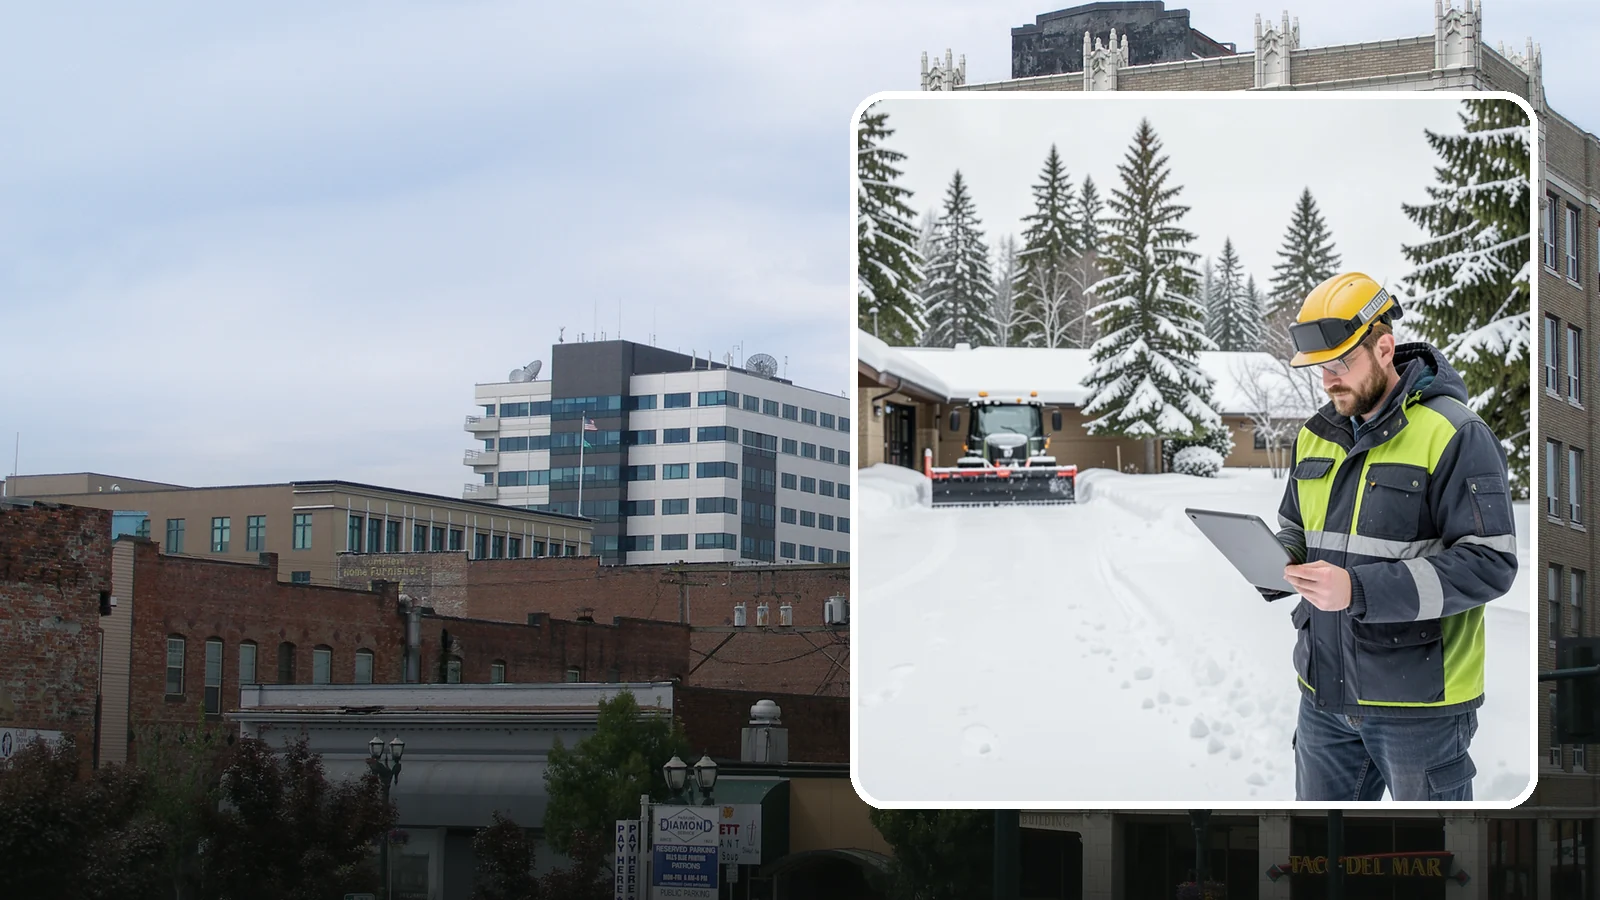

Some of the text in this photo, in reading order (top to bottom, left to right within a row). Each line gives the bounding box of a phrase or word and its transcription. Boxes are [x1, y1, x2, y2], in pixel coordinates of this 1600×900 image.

[343, 566, 427, 577] Home Furnishers
[660, 818, 713, 833] DIAMOND
[1022, 815, 1070, 828] BUILDING
[689, 846, 716, 854] PARKING
[616, 825, 625, 893] PAY HERE
[627, 824, 636, 893] PAY HERE
[721, 852, 739, 862] Soup
[671, 862, 701, 870] PATRONS
[1289, 855, 1442, 877] TAC DEL MAR
[660, 888, 710, 898] PUBLIC PARKING
